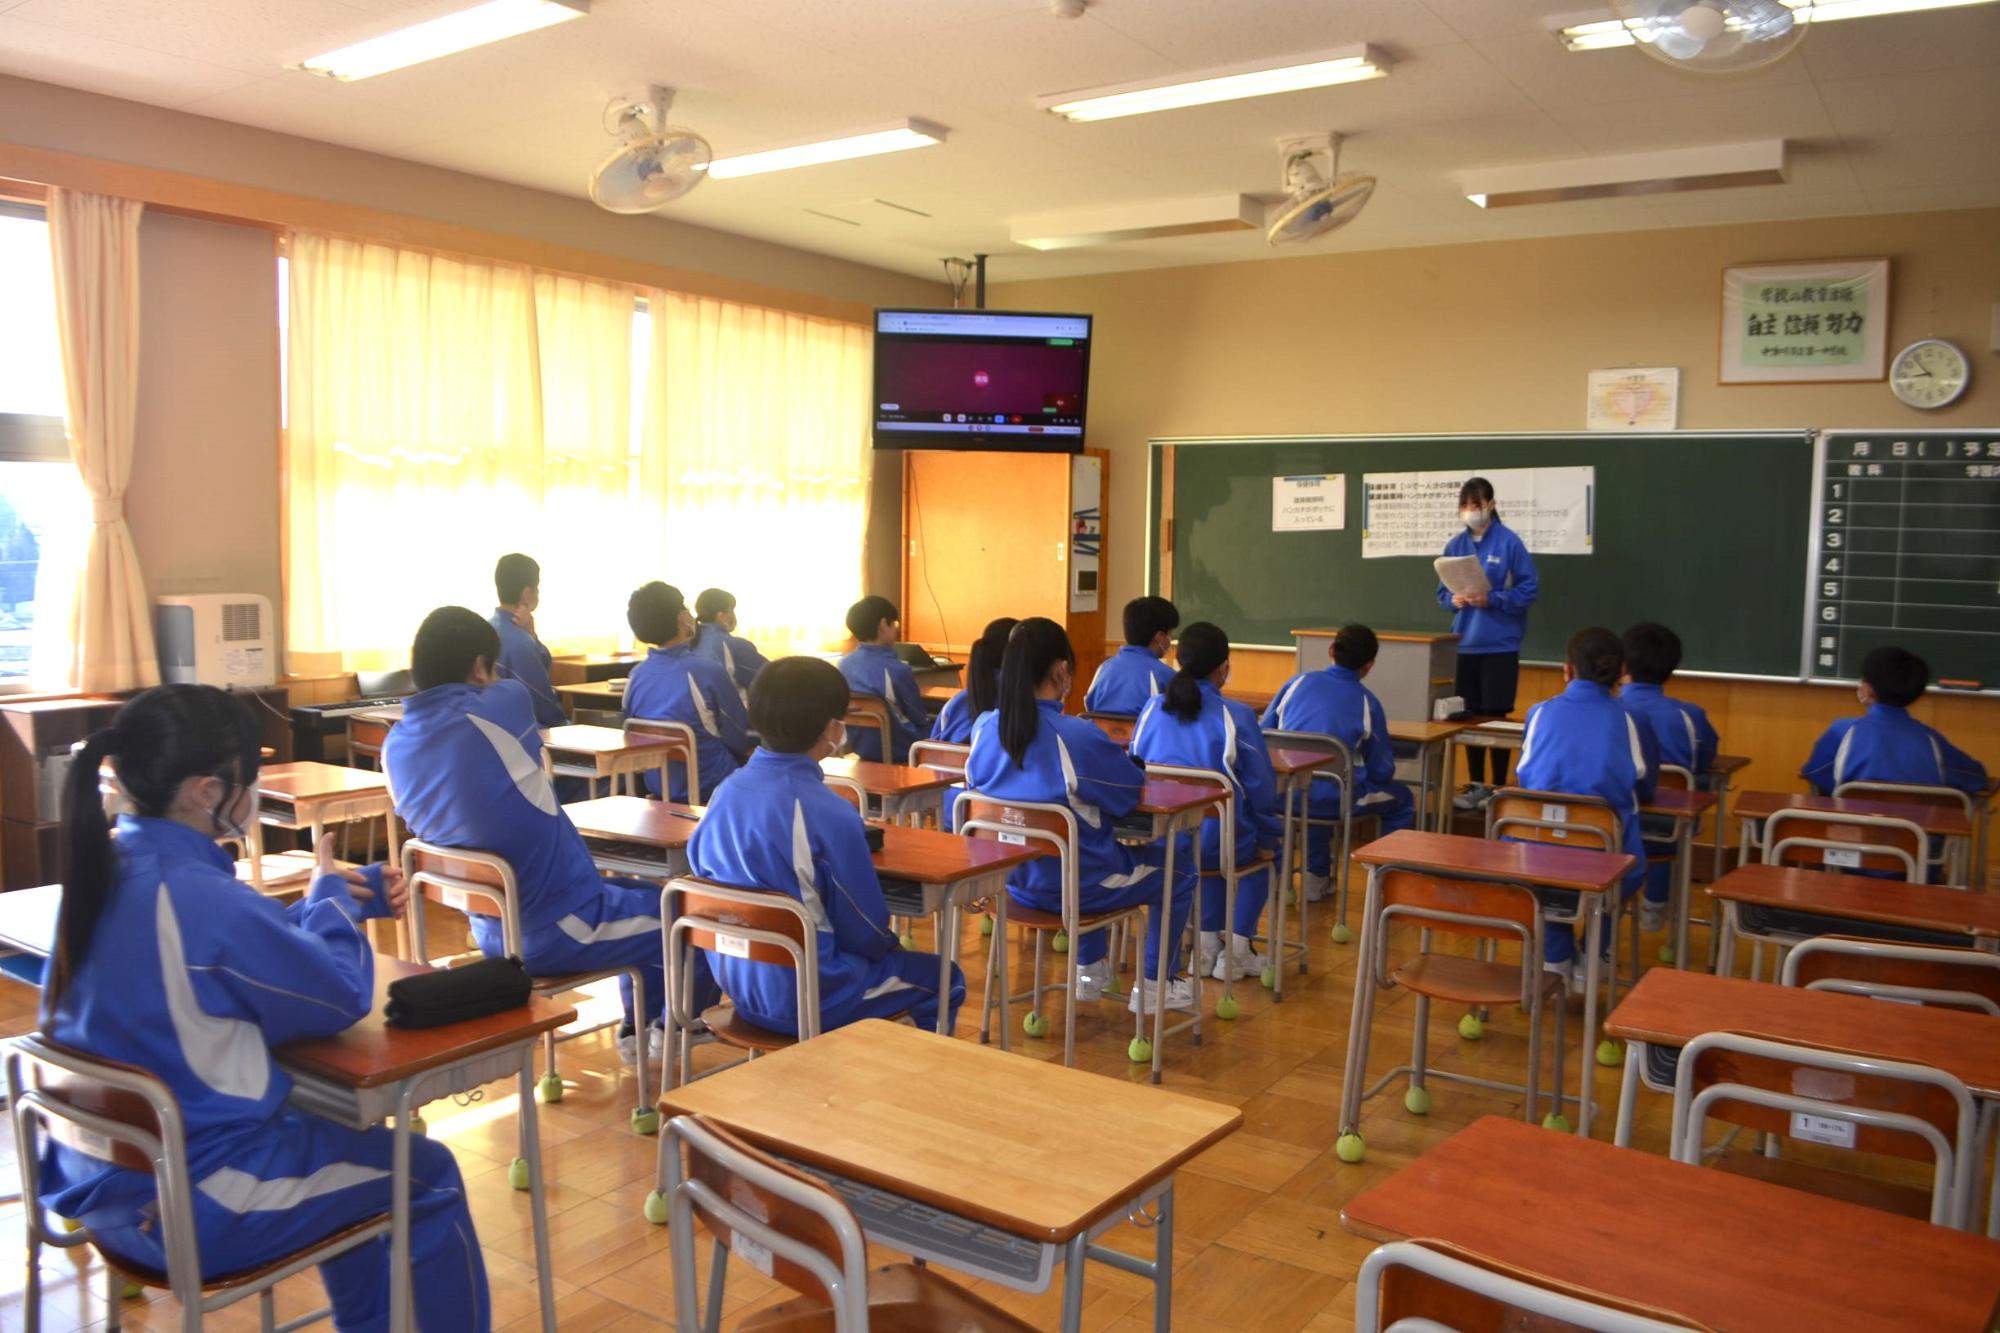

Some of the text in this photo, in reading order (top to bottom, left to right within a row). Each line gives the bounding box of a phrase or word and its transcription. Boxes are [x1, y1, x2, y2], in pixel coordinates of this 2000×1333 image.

[1825, 311, 1864, 335] 努力
[1832, 484, 1842, 498] 1
[1828, 509, 1842, 523] 2
[1826, 533, 1841, 547] 3
[1825, 558, 1840, 571] 4
[1823, 582, 1838, 596] 5
[1822, 606, 1837, 620] 6
